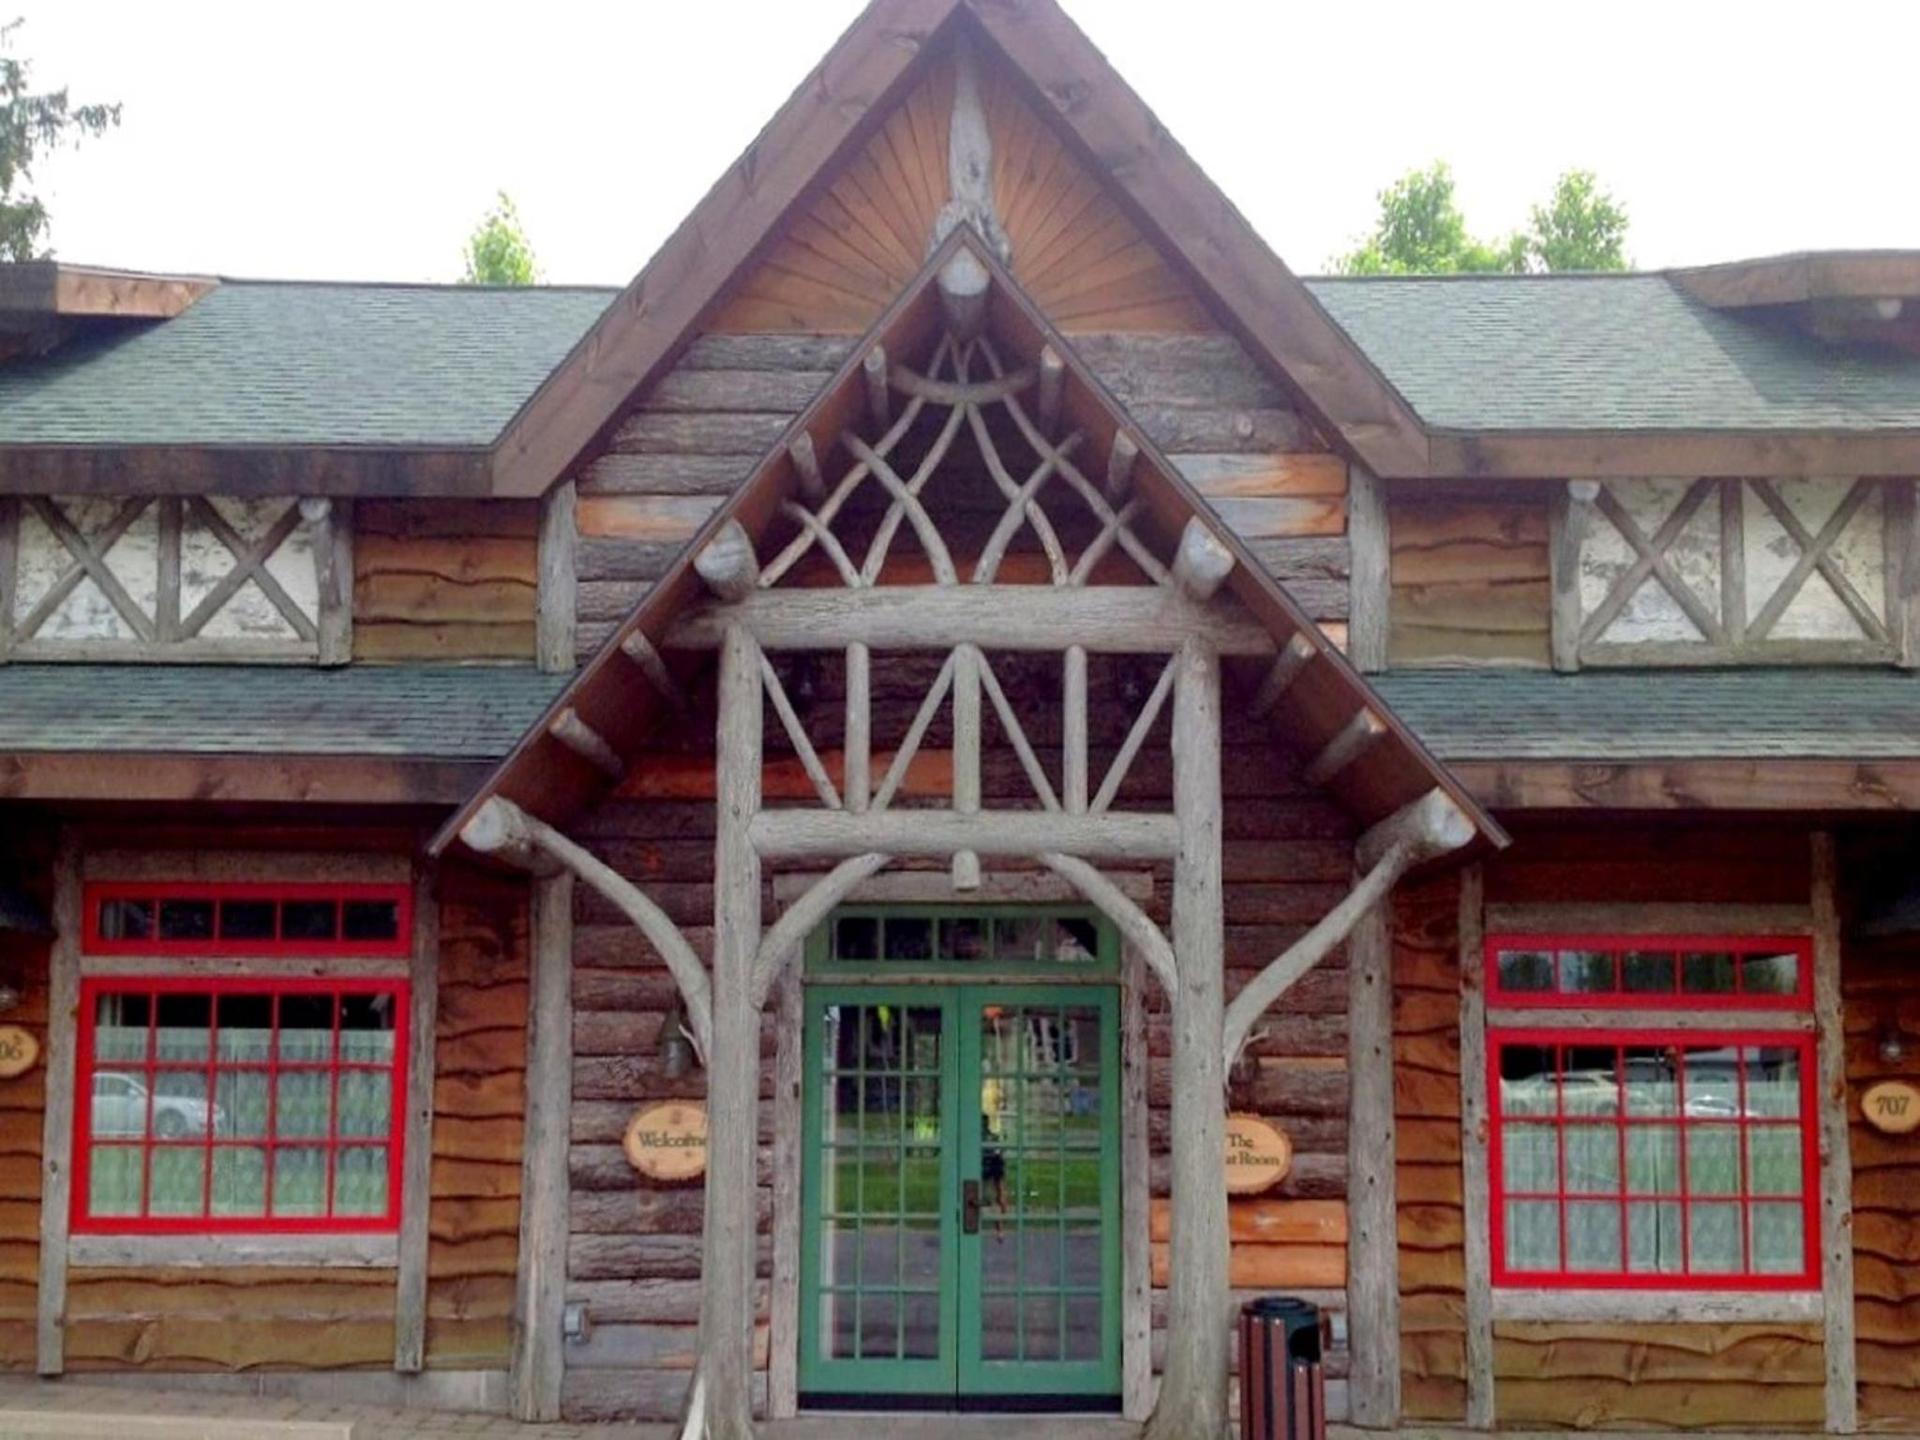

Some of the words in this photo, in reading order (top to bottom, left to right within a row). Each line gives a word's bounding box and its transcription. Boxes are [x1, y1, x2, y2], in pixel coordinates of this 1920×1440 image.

[1875, 1094, 1910, 1116] 707
[1227, 1132, 1254, 1149] The
[1238, 1150, 1280, 1167] Room
